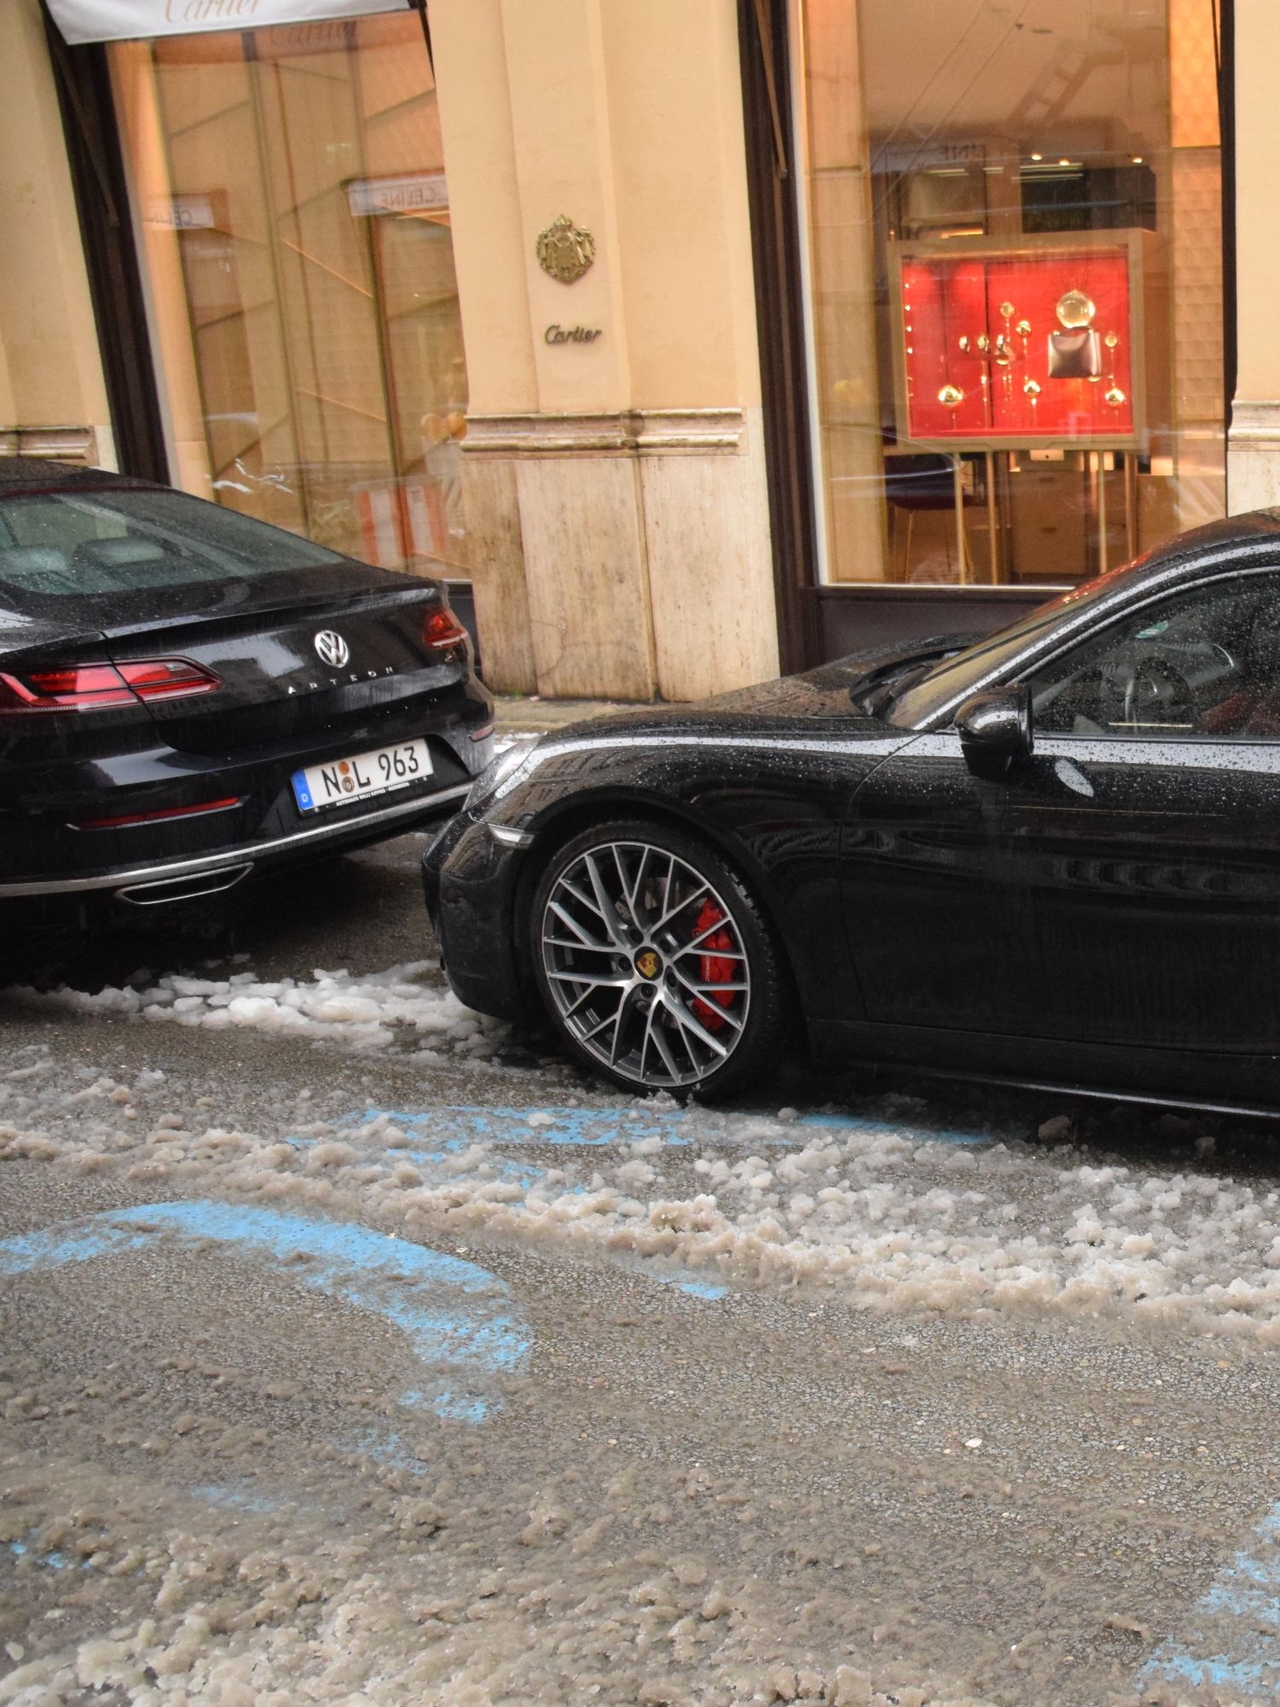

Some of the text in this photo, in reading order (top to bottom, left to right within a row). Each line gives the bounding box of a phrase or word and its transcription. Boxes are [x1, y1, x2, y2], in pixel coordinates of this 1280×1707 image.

[164, 0, 259, 23] Cartier
[545, 325, 602, 344] Cartier
[378, 746, 419, 781] 963
